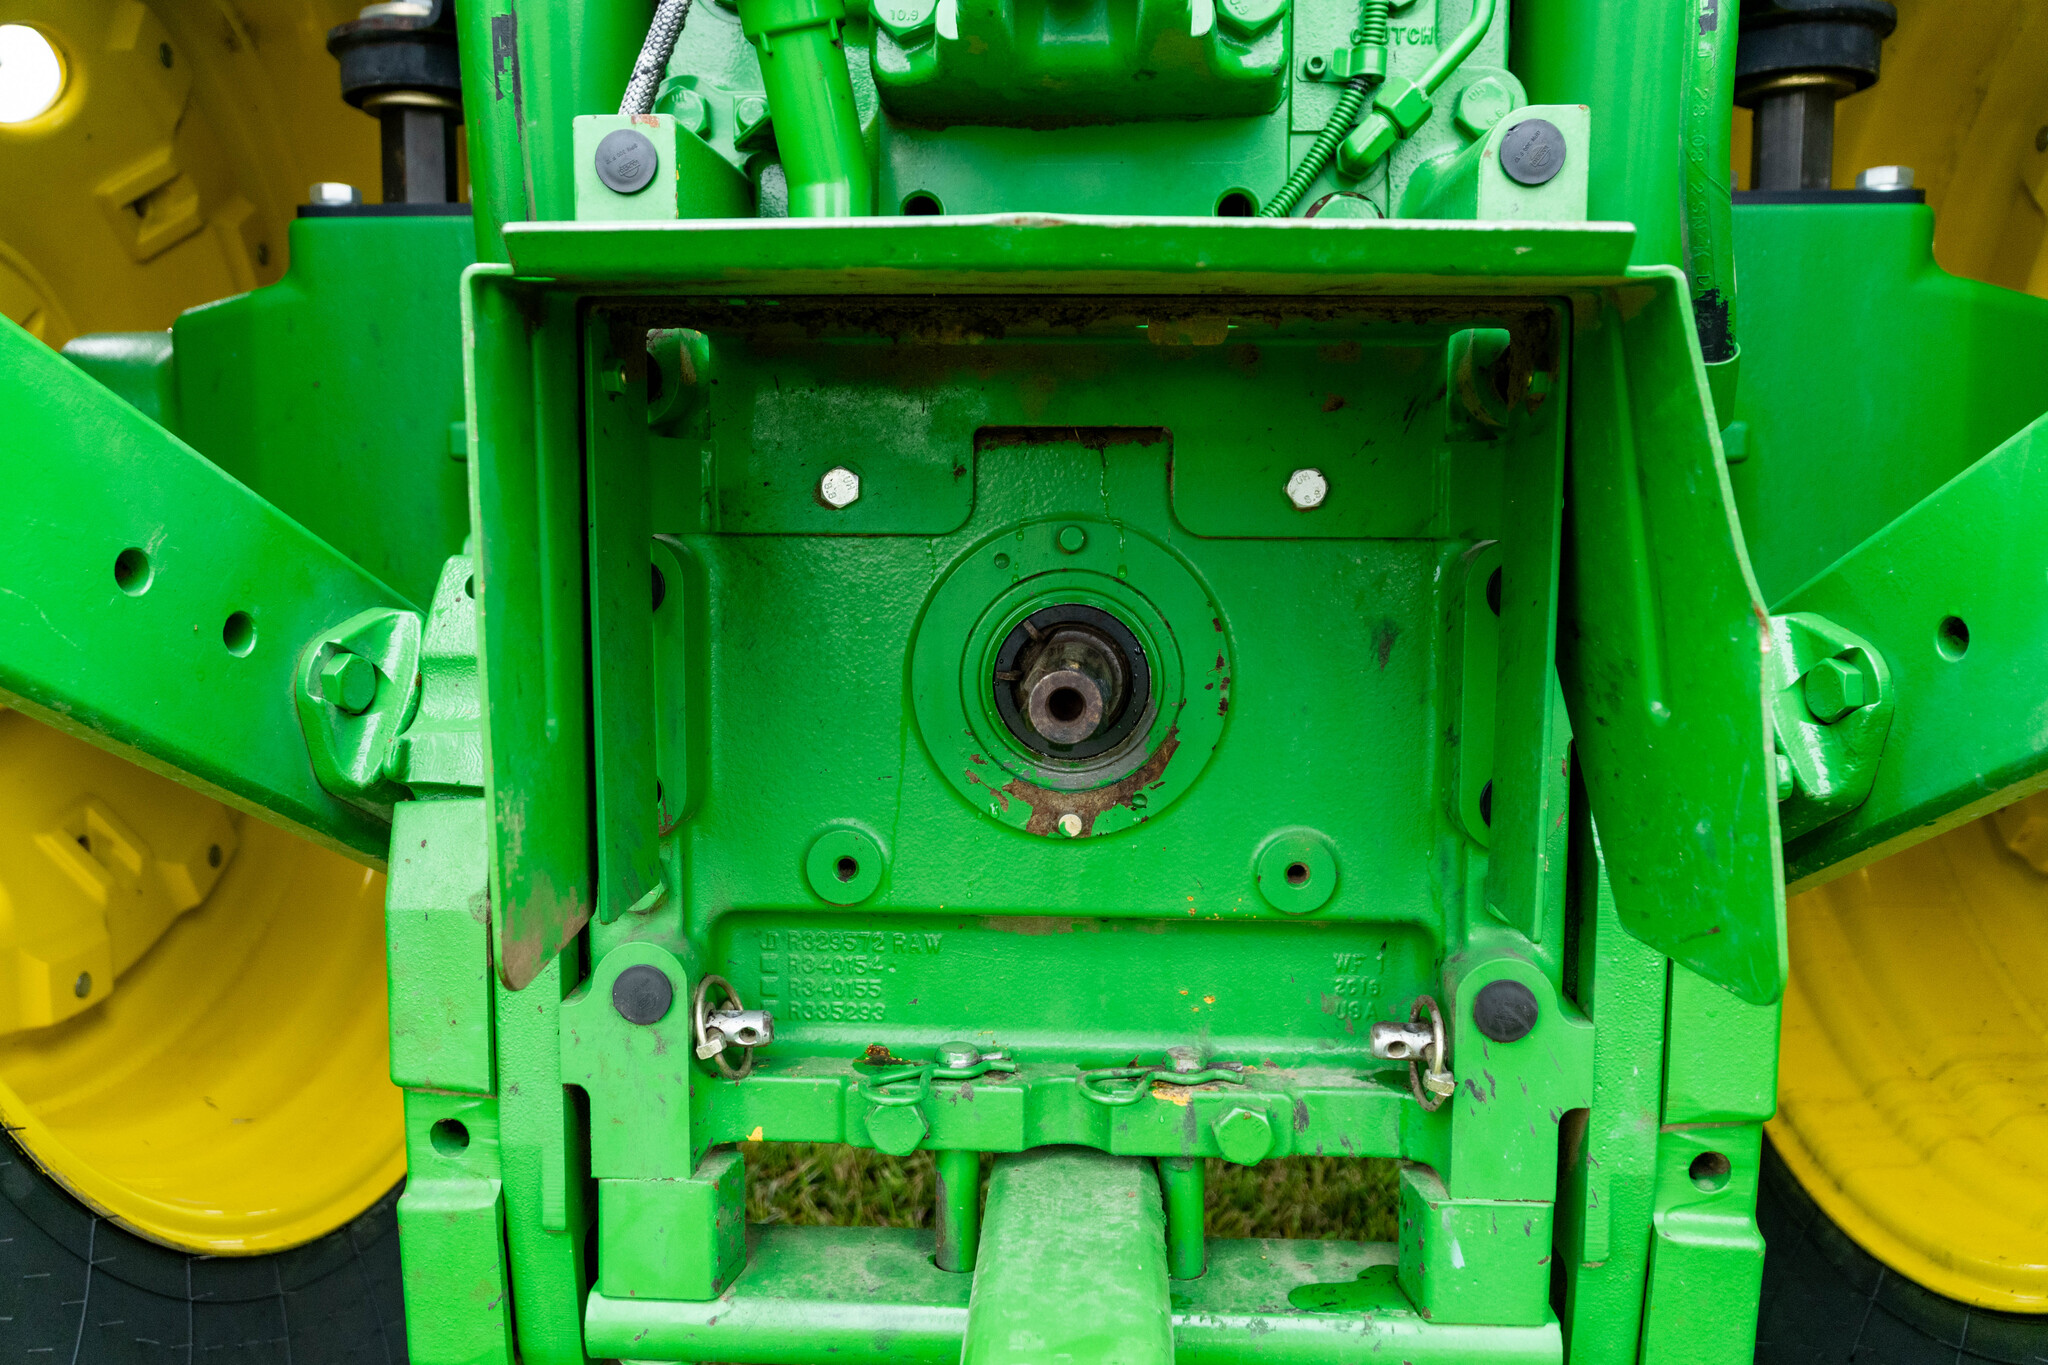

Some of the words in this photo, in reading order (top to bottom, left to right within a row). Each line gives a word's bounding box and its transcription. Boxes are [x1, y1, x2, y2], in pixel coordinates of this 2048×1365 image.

[889, 9, 919, 21] 10.9
[1468, 85, 1486, 101] UH
[843, 475, 856, 491] UH
[1295, 471, 1311, 485] UH
[824, 482, 837, 500] 8.8
[1303, 489, 1322, 504] 8.8
[787, 930, 885, 953] R329572
[892, 933, 943, 954] RAW
[787, 976, 882, 998] R340155
[1335, 1000, 1379, 1020] USA
